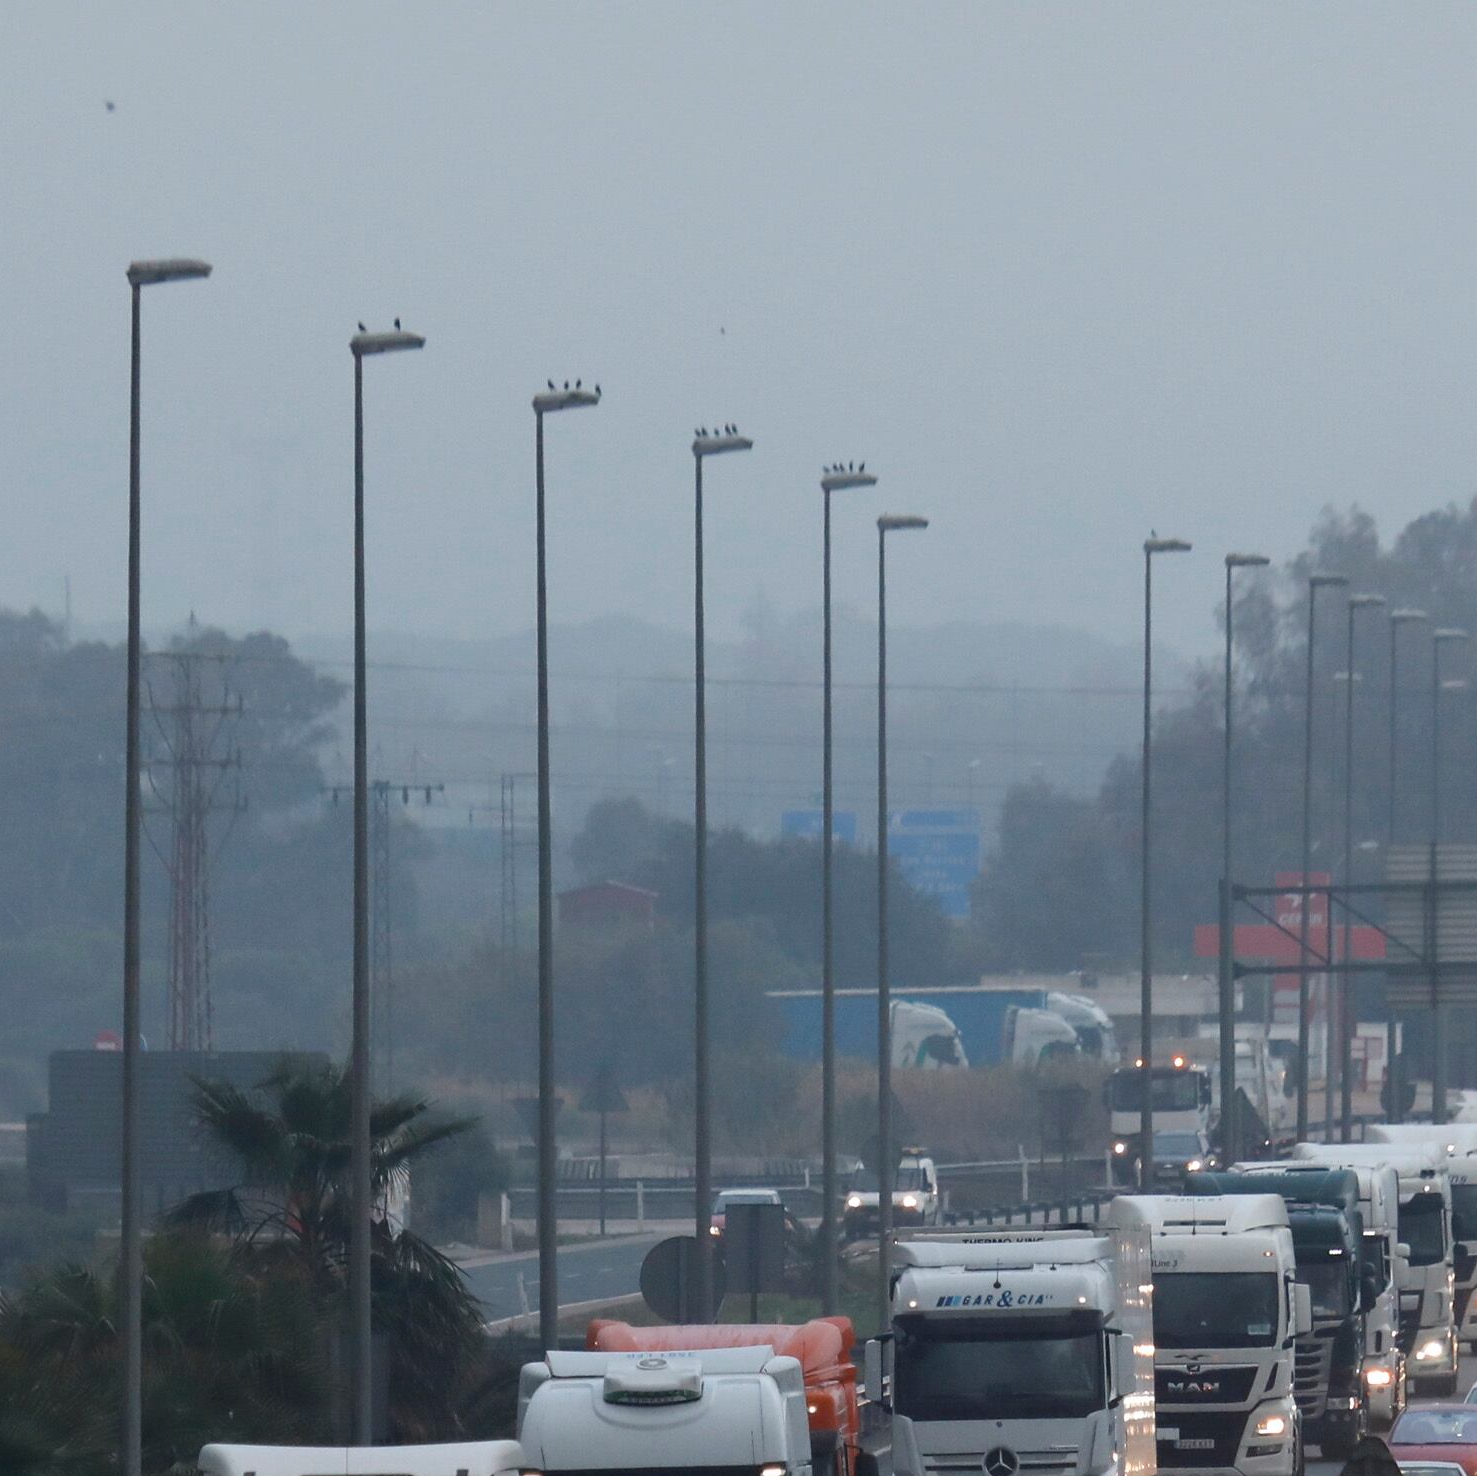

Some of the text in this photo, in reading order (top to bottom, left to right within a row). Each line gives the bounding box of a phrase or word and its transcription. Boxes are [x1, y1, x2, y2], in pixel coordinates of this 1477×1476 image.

[961, 1290, 1045, 1308] GAR & CIA
[1167, 1381, 1220, 1394] MAN
